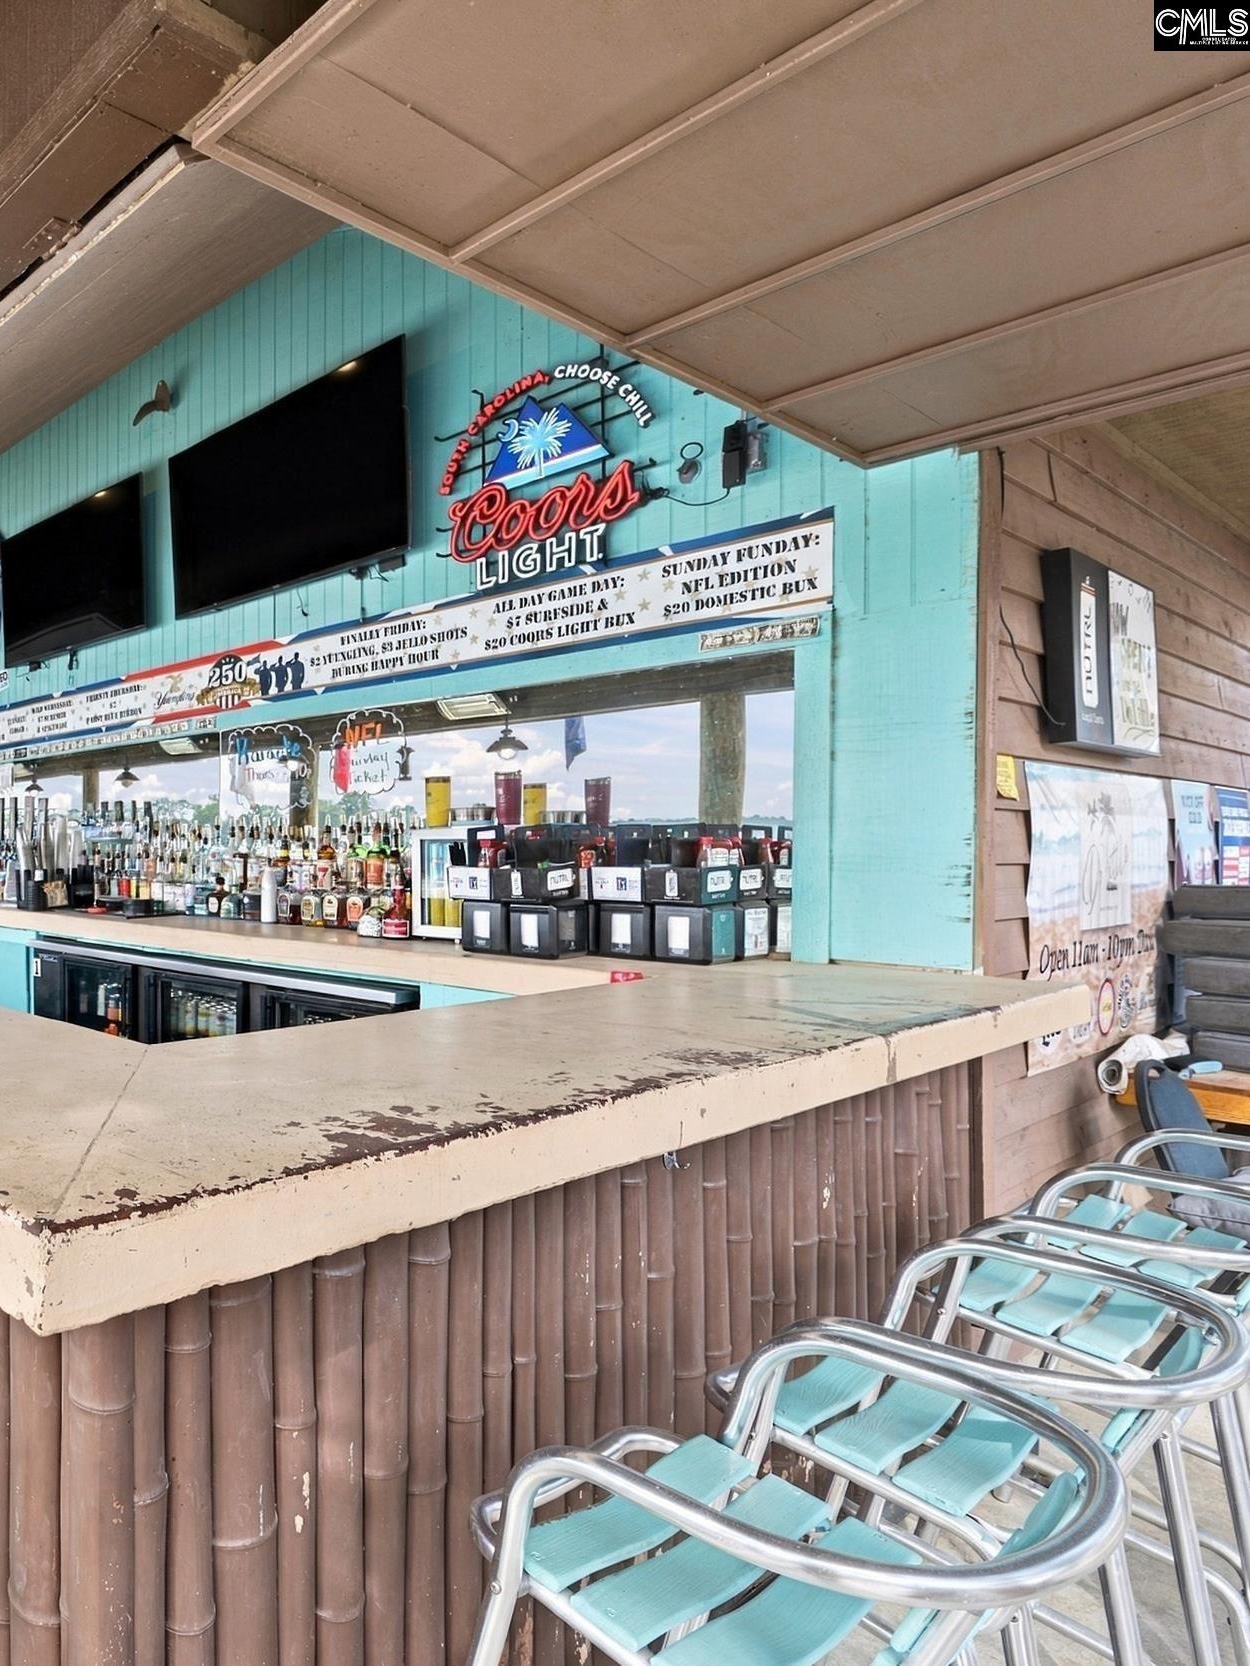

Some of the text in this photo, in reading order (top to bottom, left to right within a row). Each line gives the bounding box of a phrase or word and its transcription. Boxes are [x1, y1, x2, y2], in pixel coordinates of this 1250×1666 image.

[438, 364, 654, 496] SOUTH CAROLINA, CHOOSE CHILL
[449, 459, 640, 563] Coors
[476, 523, 607, 591] LIGHT
[661, 532, 821, 579] SUNDAY FUNDAY:
[493, 576, 626, 615] ALL DAY GAME DAY:
[681, 559, 798, 596] NFL EDITION
[506, 597, 609, 630] $7 SURFSIDE &
[663, 577, 819, 618] $20 DOMESTIC BUX
[340, 619, 427, 647] FINALLY FRIDAY:
[395, 635, 428, 652] JELLO
[430, 626, 468, 644] SHOTS
[484, 611, 636, 652] $20 COORS LIGHT BUX
[208, 660, 247, 689] 250
[331, 649, 440, 680] DURING HAPPY HOUR
[345, 722, 390, 749] NFL
[1039, 944, 1070, 982] Open
[1072, 940, 1099, 968] 11am
[1106, 934, 1135, 969] 10pm
